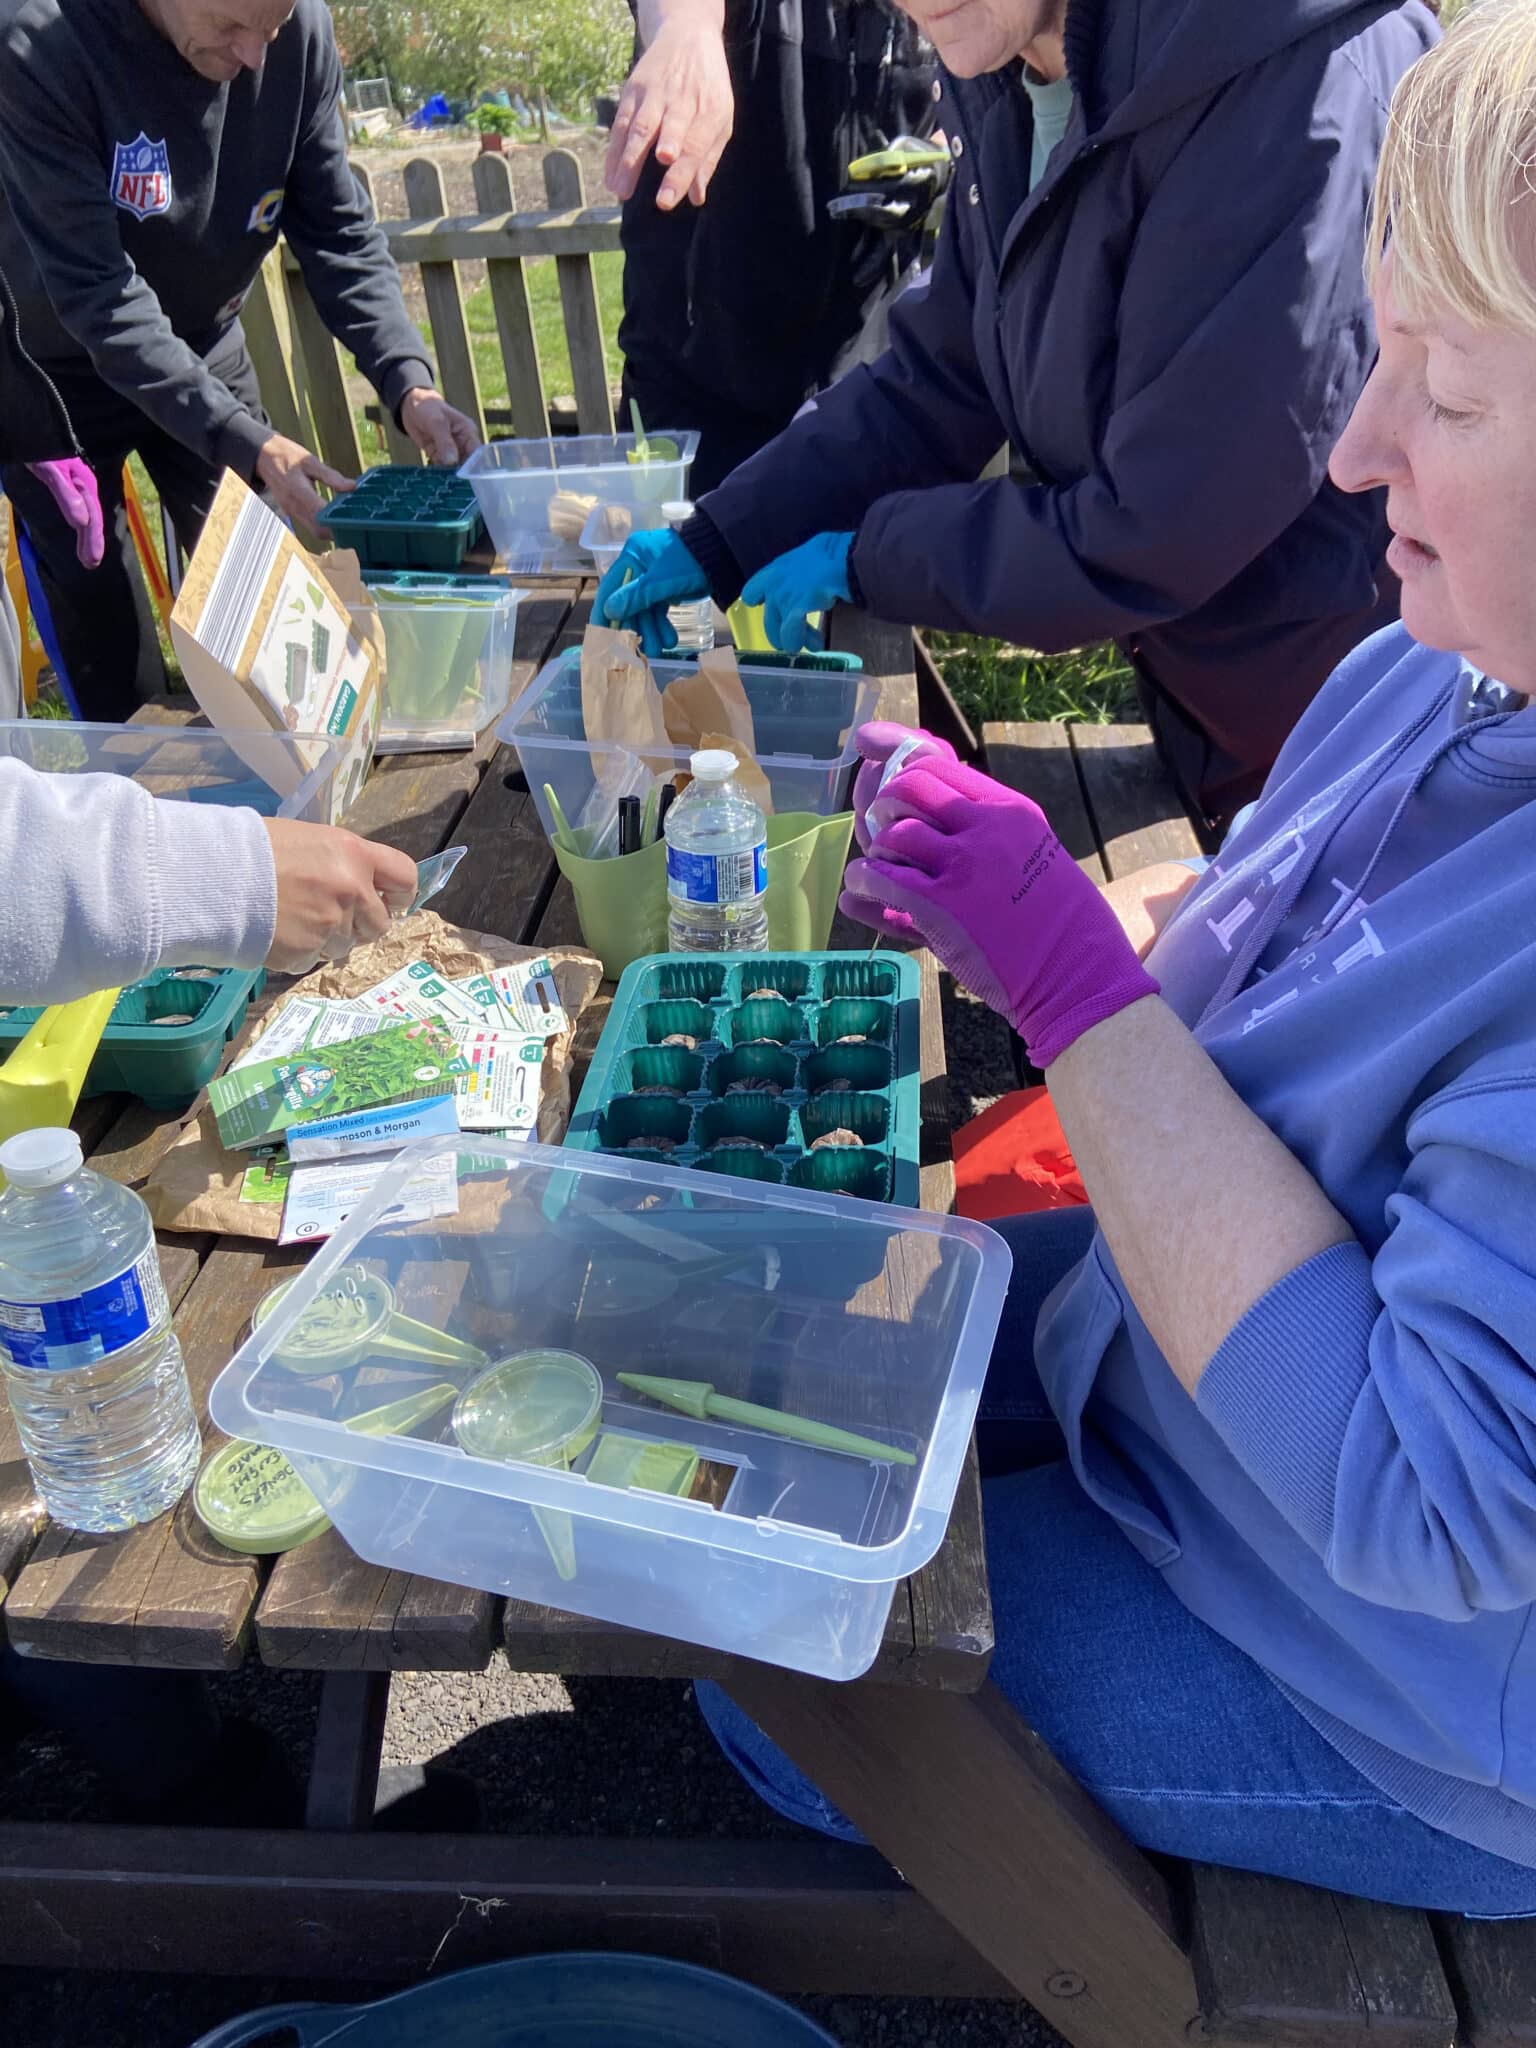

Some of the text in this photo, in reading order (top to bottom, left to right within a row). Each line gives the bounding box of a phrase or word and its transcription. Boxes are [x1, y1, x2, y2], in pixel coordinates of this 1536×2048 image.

[120, 174, 165, 209] NFL
[1011, 860, 1049, 904] Country
[297, 1122, 338, 1138] Sensation
[339, 1116, 364, 1129] Mixed
[330, 1127, 372, 1141] ompson
[374, 1126, 382, 1135] &
[384, 1119, 421, 1133] Morgan
